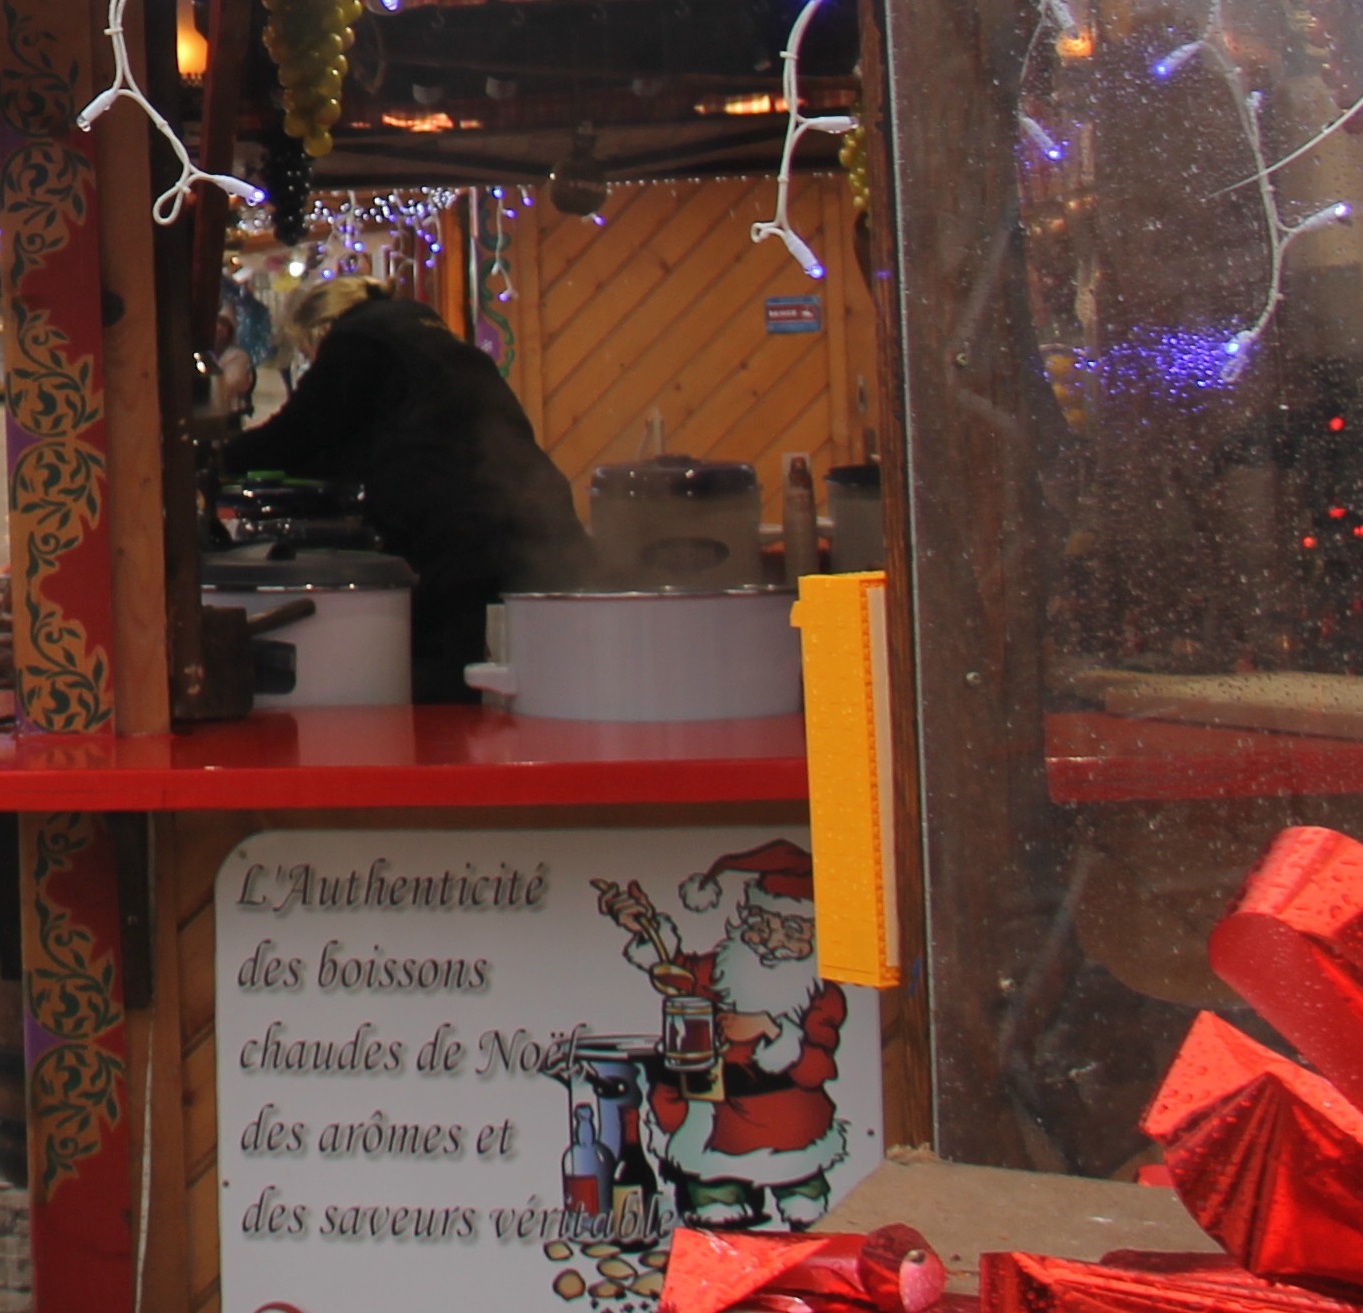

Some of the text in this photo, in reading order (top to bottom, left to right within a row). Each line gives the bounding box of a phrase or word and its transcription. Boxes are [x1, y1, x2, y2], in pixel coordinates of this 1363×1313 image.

[236, 857, 546, 912] L'Authenticité
[237, 939, 490, 989] des boissons
[239, 1020, 403, 1071] chaudes
[415, 1022, 463, 1071] de
[240, 1103, 514, 1155] des arômes et
[241, 1185, 305, 1234] des
[319, 1203, 476, 1237] saveurs
